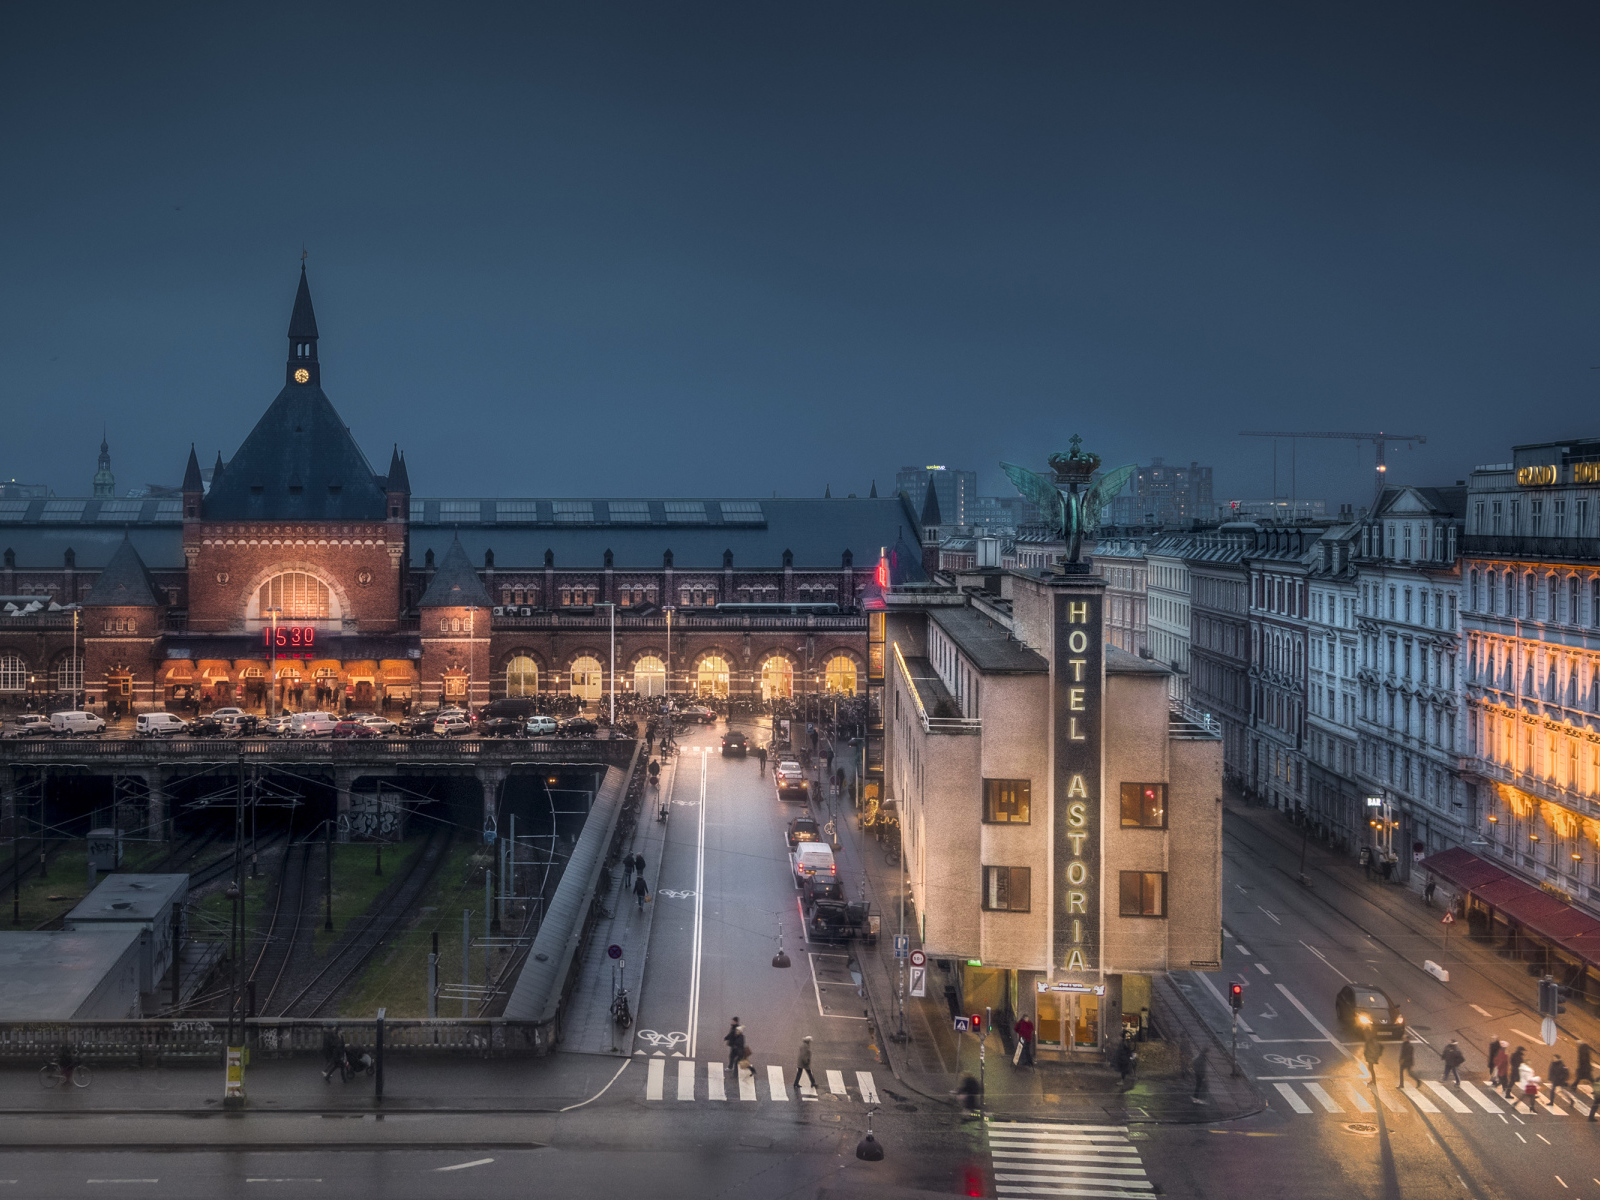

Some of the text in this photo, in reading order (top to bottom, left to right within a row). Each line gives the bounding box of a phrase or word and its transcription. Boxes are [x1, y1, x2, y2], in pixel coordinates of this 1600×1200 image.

[1068, 601, 1088, 741] HOTEL
[1367, 797, 1382, 806] BAR
[1067, 774, 1087, 971] ASTORIA
[897, 937, 906, 949] P
[914, 970, 921, 979] P
